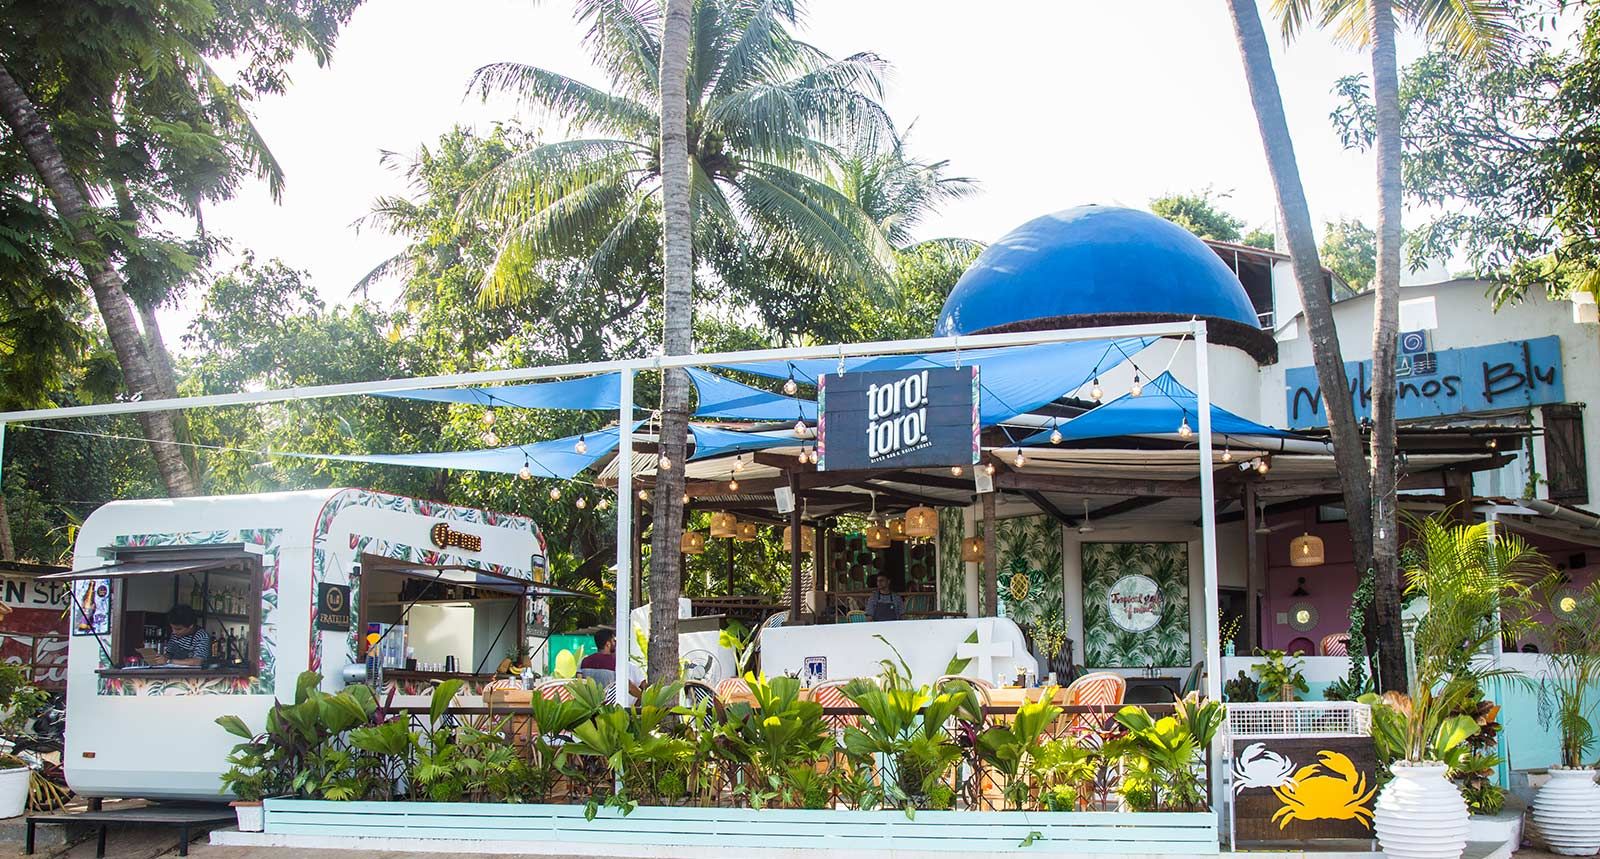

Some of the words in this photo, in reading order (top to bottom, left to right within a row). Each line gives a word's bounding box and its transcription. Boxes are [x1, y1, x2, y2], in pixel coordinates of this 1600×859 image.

[866, 370, 929, 421] toro!
[1293, 361, 1461, 420] Mknos
[1482, 340, 1556, 404] Blu
[866, 407, 929, 458] toro!
[430, 522, 482, 552] Corona
[320, 613, 349, 624] FRATELLI
